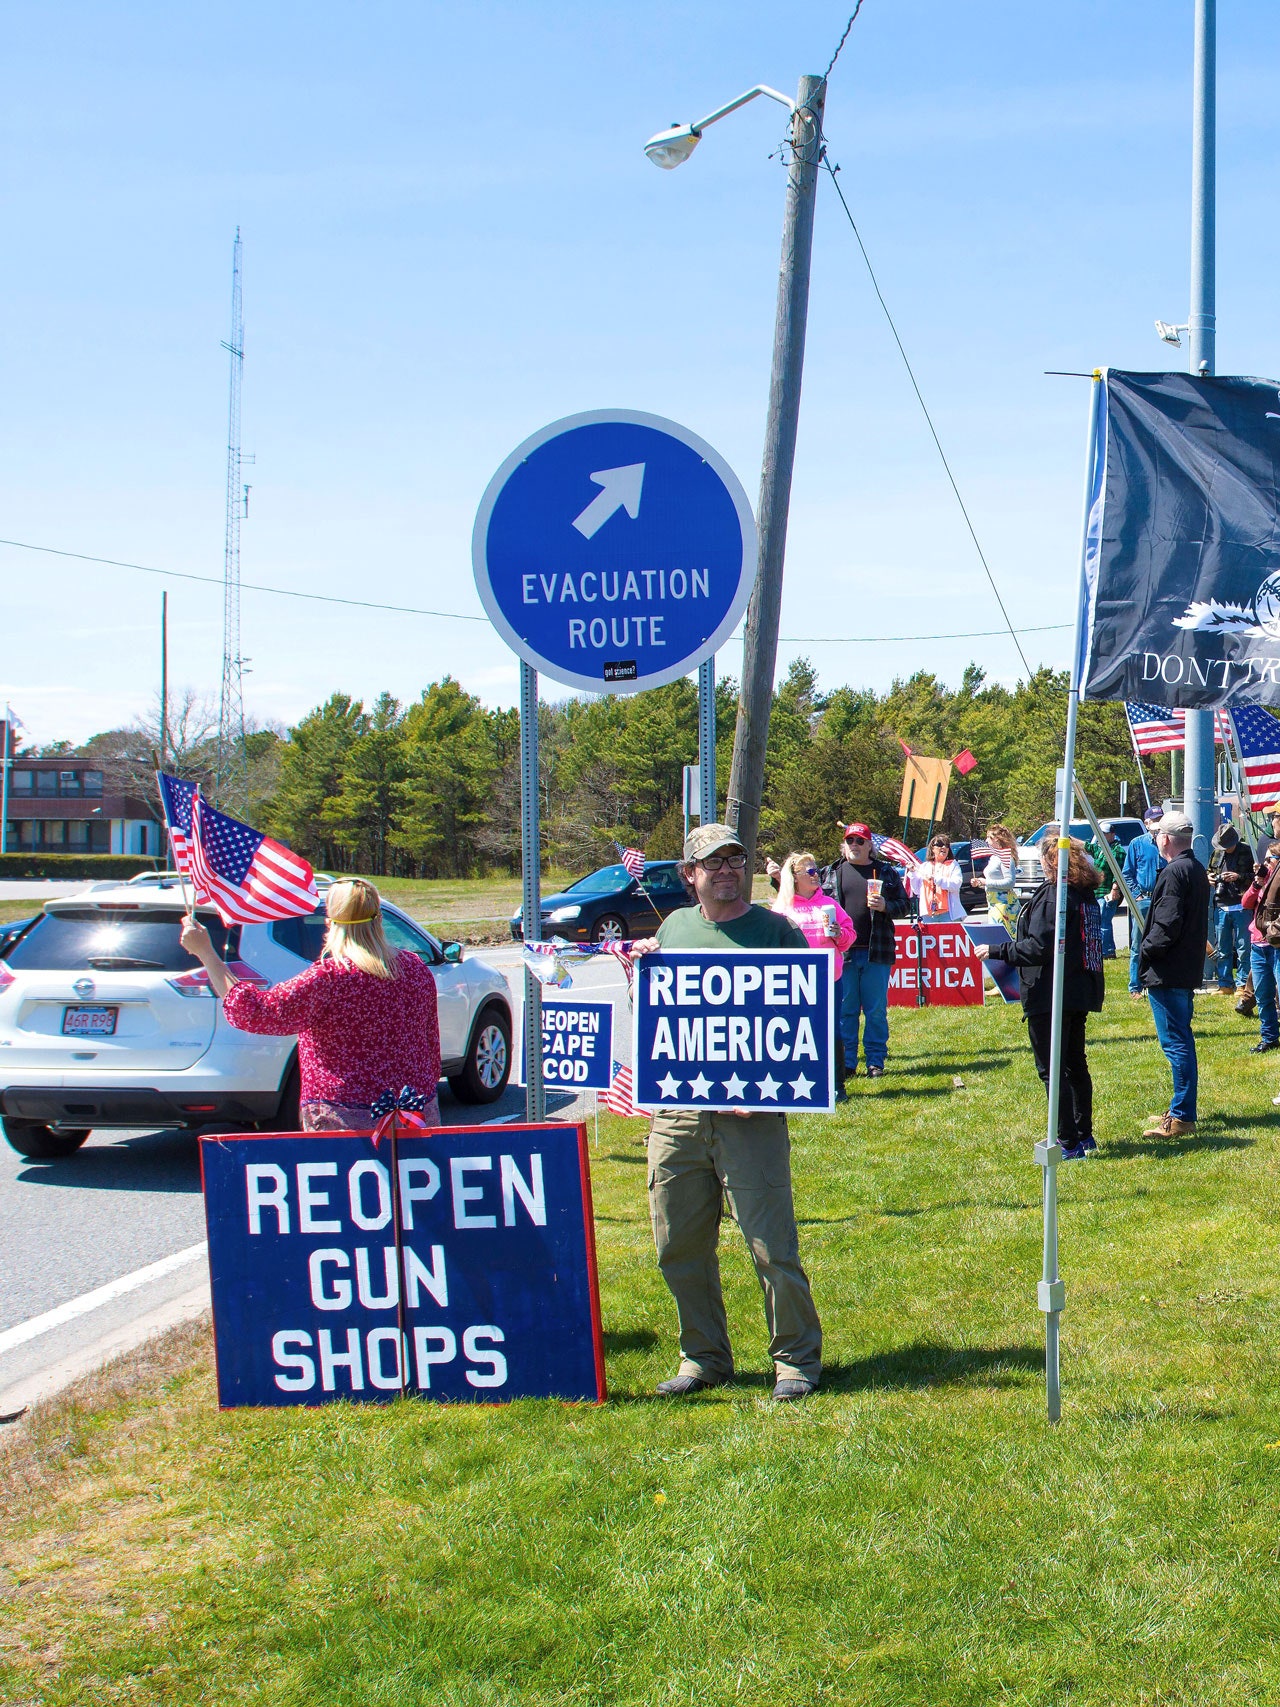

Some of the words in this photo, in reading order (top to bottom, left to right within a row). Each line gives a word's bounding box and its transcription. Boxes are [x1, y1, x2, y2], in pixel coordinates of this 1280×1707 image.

[522, 568, 710, 604] EVACUATION
[568, 616, 667, 649] ROUTE
[604, 667, 614, 678] got
[894, 934, 971, 959] EOPEN
[650, 964, 817, 1006] REOPEN
[888, 967, 975, 989] MERICA
[651, 1016, 819, 1062] AMERICA
[543, 1058, 588, 1082] COD
[245, 1153, 547, 1235] REOPEN
[309, 1244, 448, 1311] GUN
[271, 1324, 508, 1392] SHOPS
